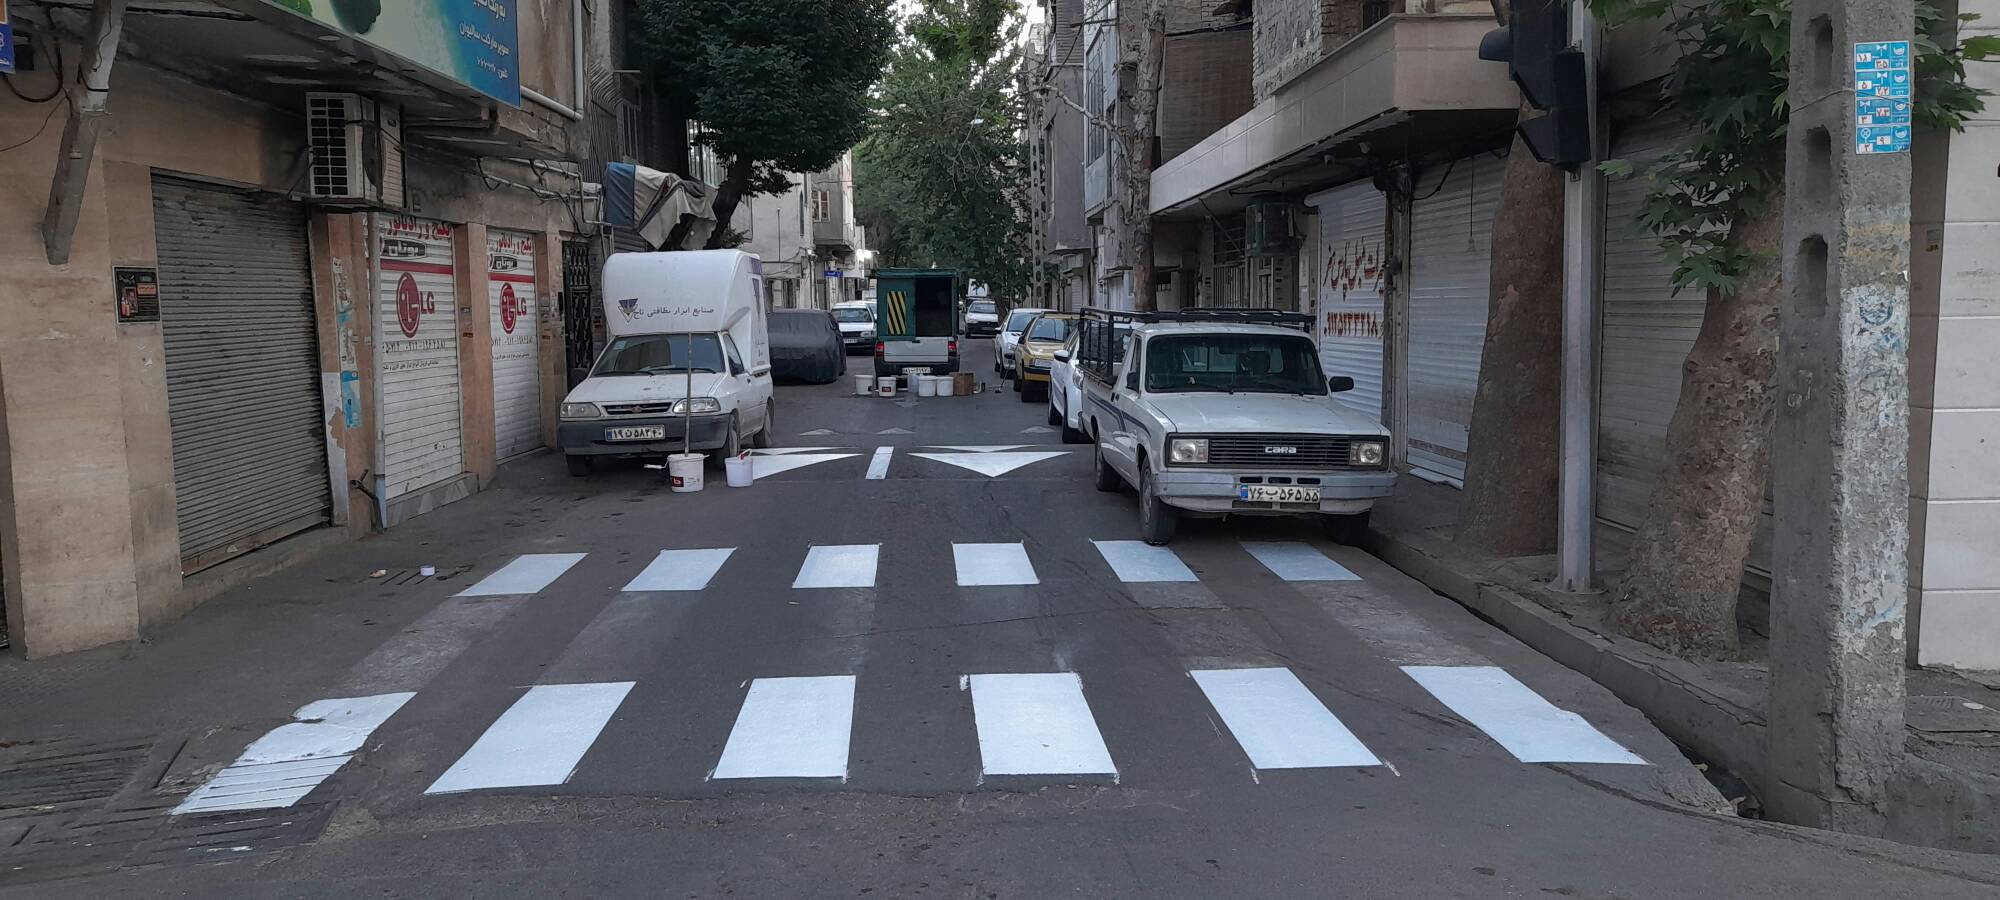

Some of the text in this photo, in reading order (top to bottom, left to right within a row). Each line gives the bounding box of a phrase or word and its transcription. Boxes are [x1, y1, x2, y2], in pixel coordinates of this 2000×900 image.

[420, 291, 435, 315] LG
[516, 298, 527, 316] LG
[646, 305, 671, 318] نظافتی
[673, 305, 691, 316] ابزار
[692, 306, 714, 317] صنایع
